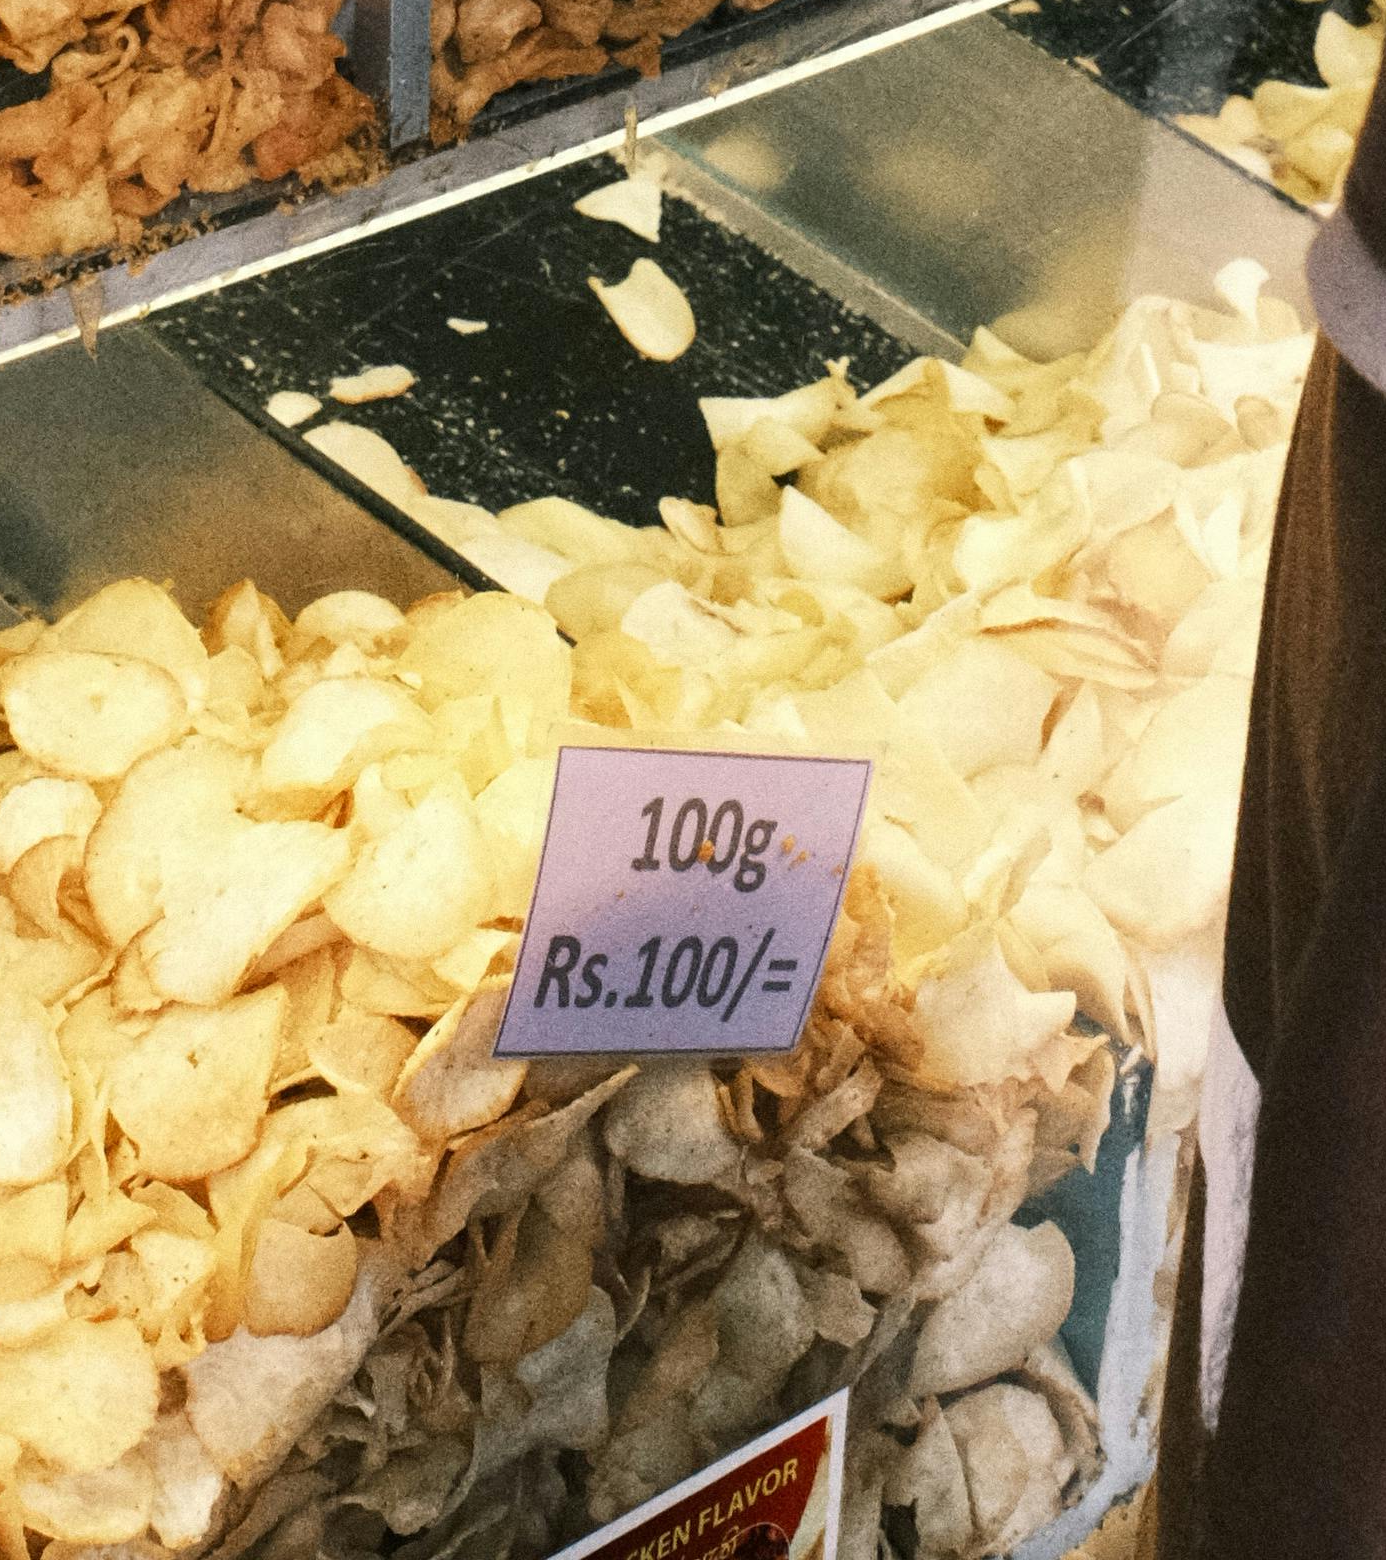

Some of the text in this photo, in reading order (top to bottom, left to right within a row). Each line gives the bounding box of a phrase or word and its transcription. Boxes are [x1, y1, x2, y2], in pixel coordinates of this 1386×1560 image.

[630, 795, 778, 893] 100g
[533, 927, 798, 1023] Rs.100/=
[697, 1458, 799, 1537] FLAVOR
